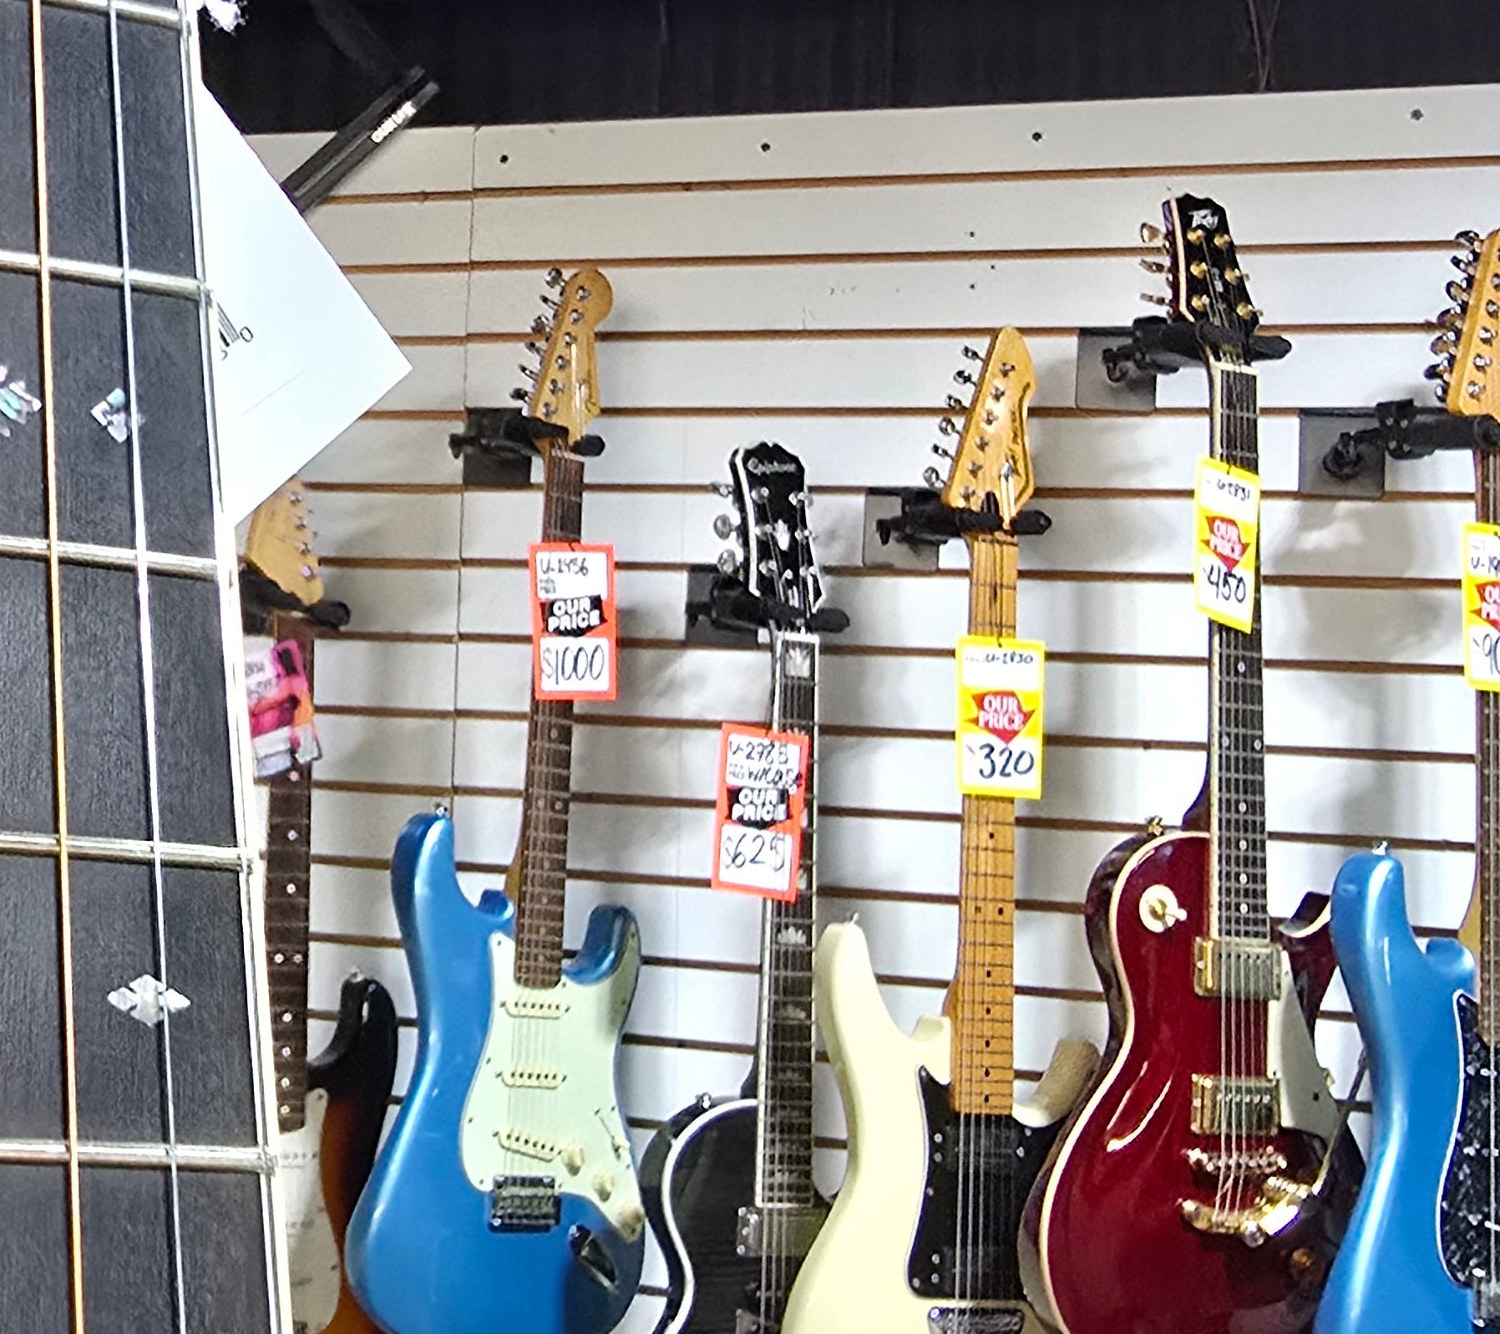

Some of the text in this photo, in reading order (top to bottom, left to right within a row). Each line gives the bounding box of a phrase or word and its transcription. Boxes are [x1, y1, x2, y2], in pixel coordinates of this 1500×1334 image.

[1213, 519, 1240, 544] OUR
[1209, 535, 1245, 561] PRICE
[552, 597, 591, 617] OUR
[547, 609, 601, 633] PRICE
[541, 644, 605, 685] $1000
[983, 695, 1020, 713] OUR
[978, 710, 1026, 731] PRICE
[738, 788, 779, 805] OUR
[731, 803, 788, 822] PRICE
